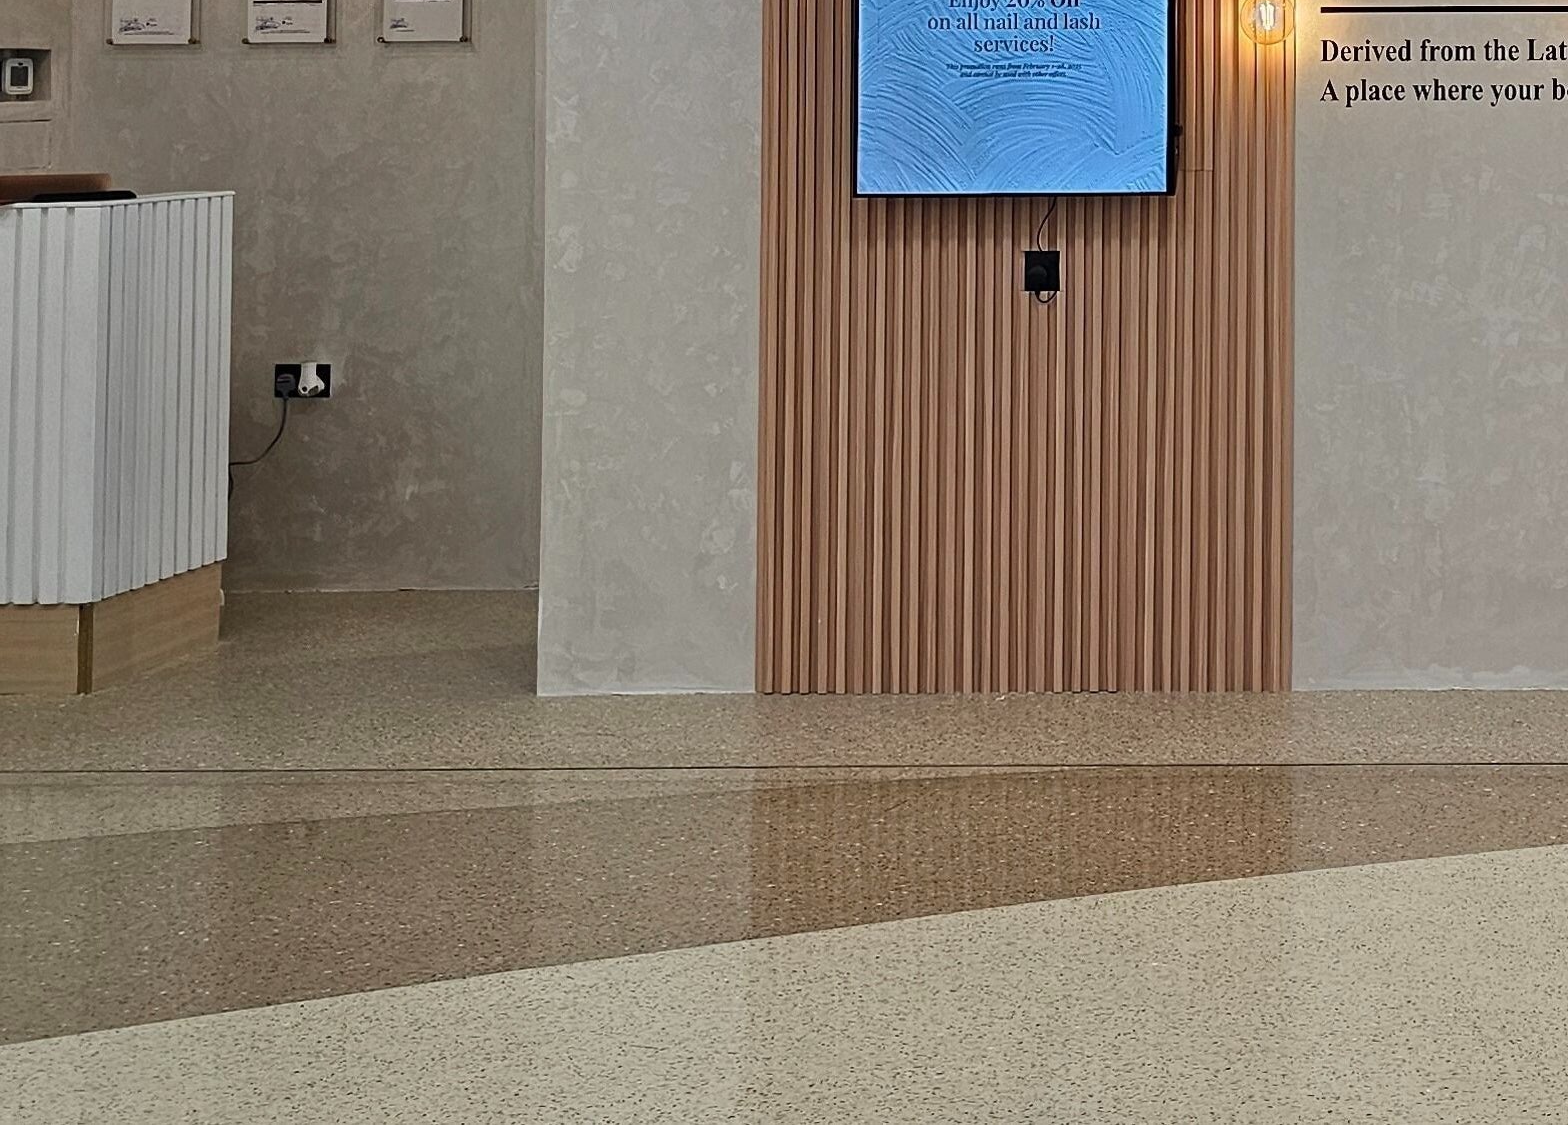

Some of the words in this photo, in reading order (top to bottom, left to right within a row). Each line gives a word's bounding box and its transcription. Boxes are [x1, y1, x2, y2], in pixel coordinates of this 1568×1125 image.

[927, 16, 951, 30] on
[956, 12, 979, 30] all
[984, 12, 1019, 30] nail
[1023, 12, 1058, 30] and
[1064, 12, 1101, 30] lash
[973, 35, 1055, 53] services!
[1320, 38, 1412, 62] Derived
[1419, 38, 1476, 62] from
[1483, 38, 1520, 62] the
[1319, 78, 1340, 102] A
[1345, 78, 1406, 108] place
[1412, 78, 1484, 101] where
[1490, 83, 1545, 107] your
